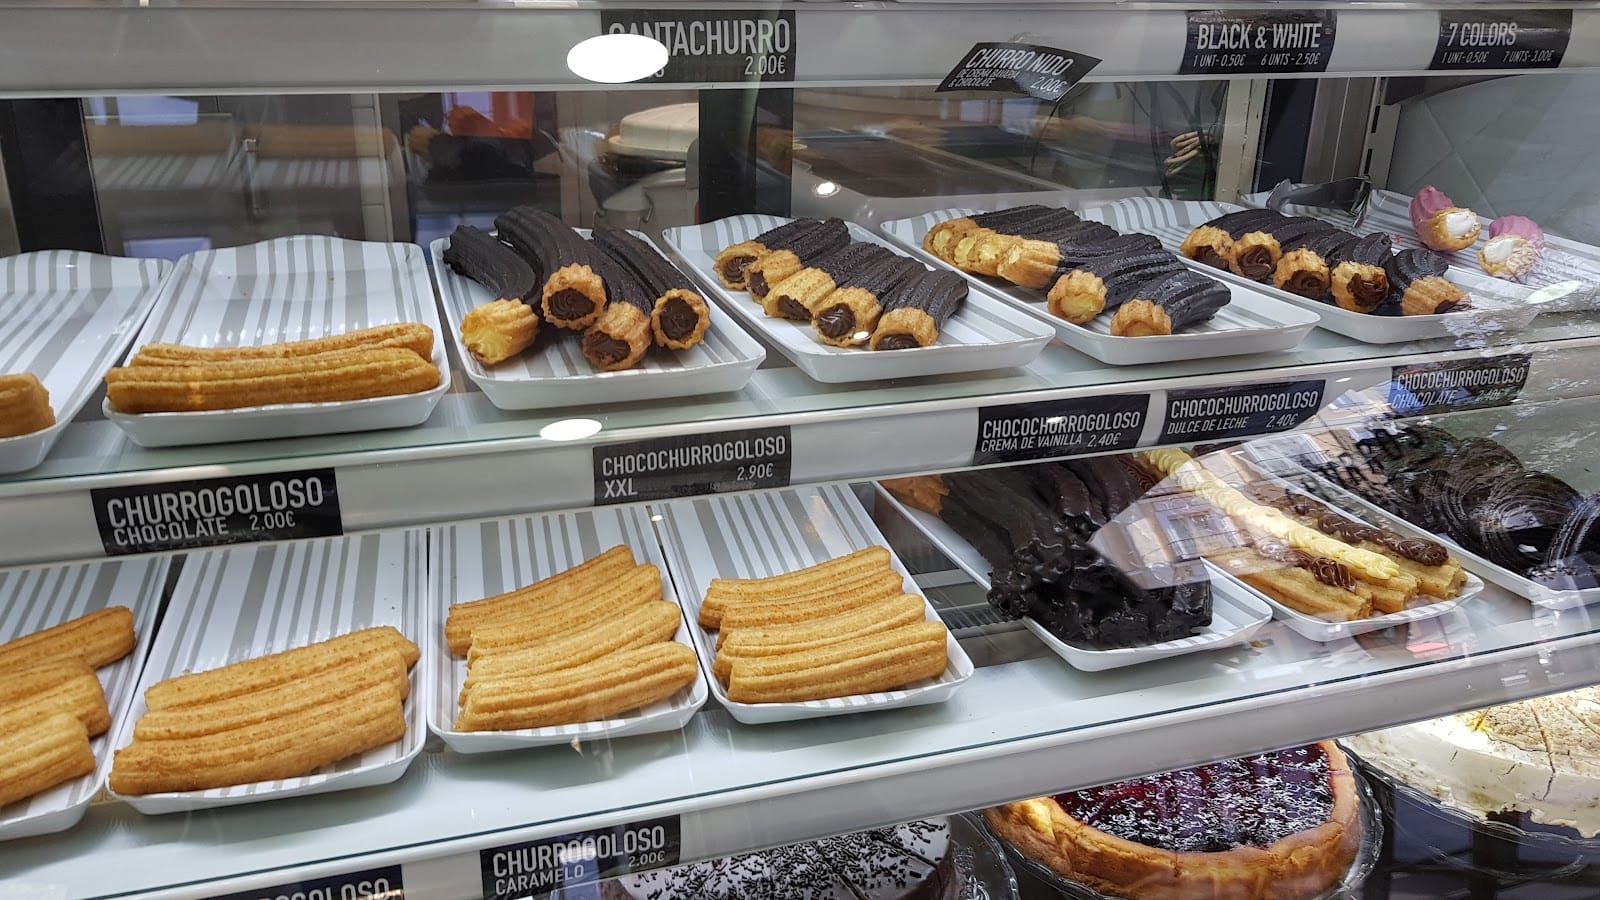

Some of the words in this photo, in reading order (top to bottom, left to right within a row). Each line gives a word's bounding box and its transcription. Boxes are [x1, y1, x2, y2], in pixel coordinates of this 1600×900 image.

[1197, 24, 1252, 50] BLACK
[1254, 26, 1268, 49] &
[1272, 23, 1322, 49] WHITE
[1447, 23, 1458, 47] 7
[1459, 22, 1518, 47] COLORS
[744, 55, 787, 75] 2.00€
[966, 48, 1036, 70] CHURRO
[1031, 53, 1074, 76] NIDO
[1193, 55, 1198, 67] 1
[1260, 54, 1267, 66] 6
[1441, 52, 1446, 63] 1
[1502, 51, 1509, 62] 7
[1397, 366, 1525, 391] CHOCOCHURROGOLOSO
[1171, 390, 1319, 419] CHOCOCHURROGOLOSO
[1391, 390, 1458, 409] CHOCOLATE
[1167, 420, 1201, 435] DULCE
[1201, 418, 1215, 432] DE
[1216, 416, 1250, 430] LECHE
[981, 438, 1018, 452] CREMA
[1021, 436, 1036, 449] DE
[1038, 433, 1083, 447] VAINILLA
[602, 435, 786, 477] CHOCOCHURROGOLOSO
[737, 463, 774, 481] 2.90€
[604, 478, 638, 498] XXL
[107, 477, 324, 528] CHURROGOLOSO
[114, 516, 229, 546] CHOCOLATE
[249, 511, 296, 531] 2.00€
[492, 825, 665, 878] CHURROGOLOSO
[495, 864, 585, 896] CARAMELO
[628, 850, 665, 868] 2.00€
